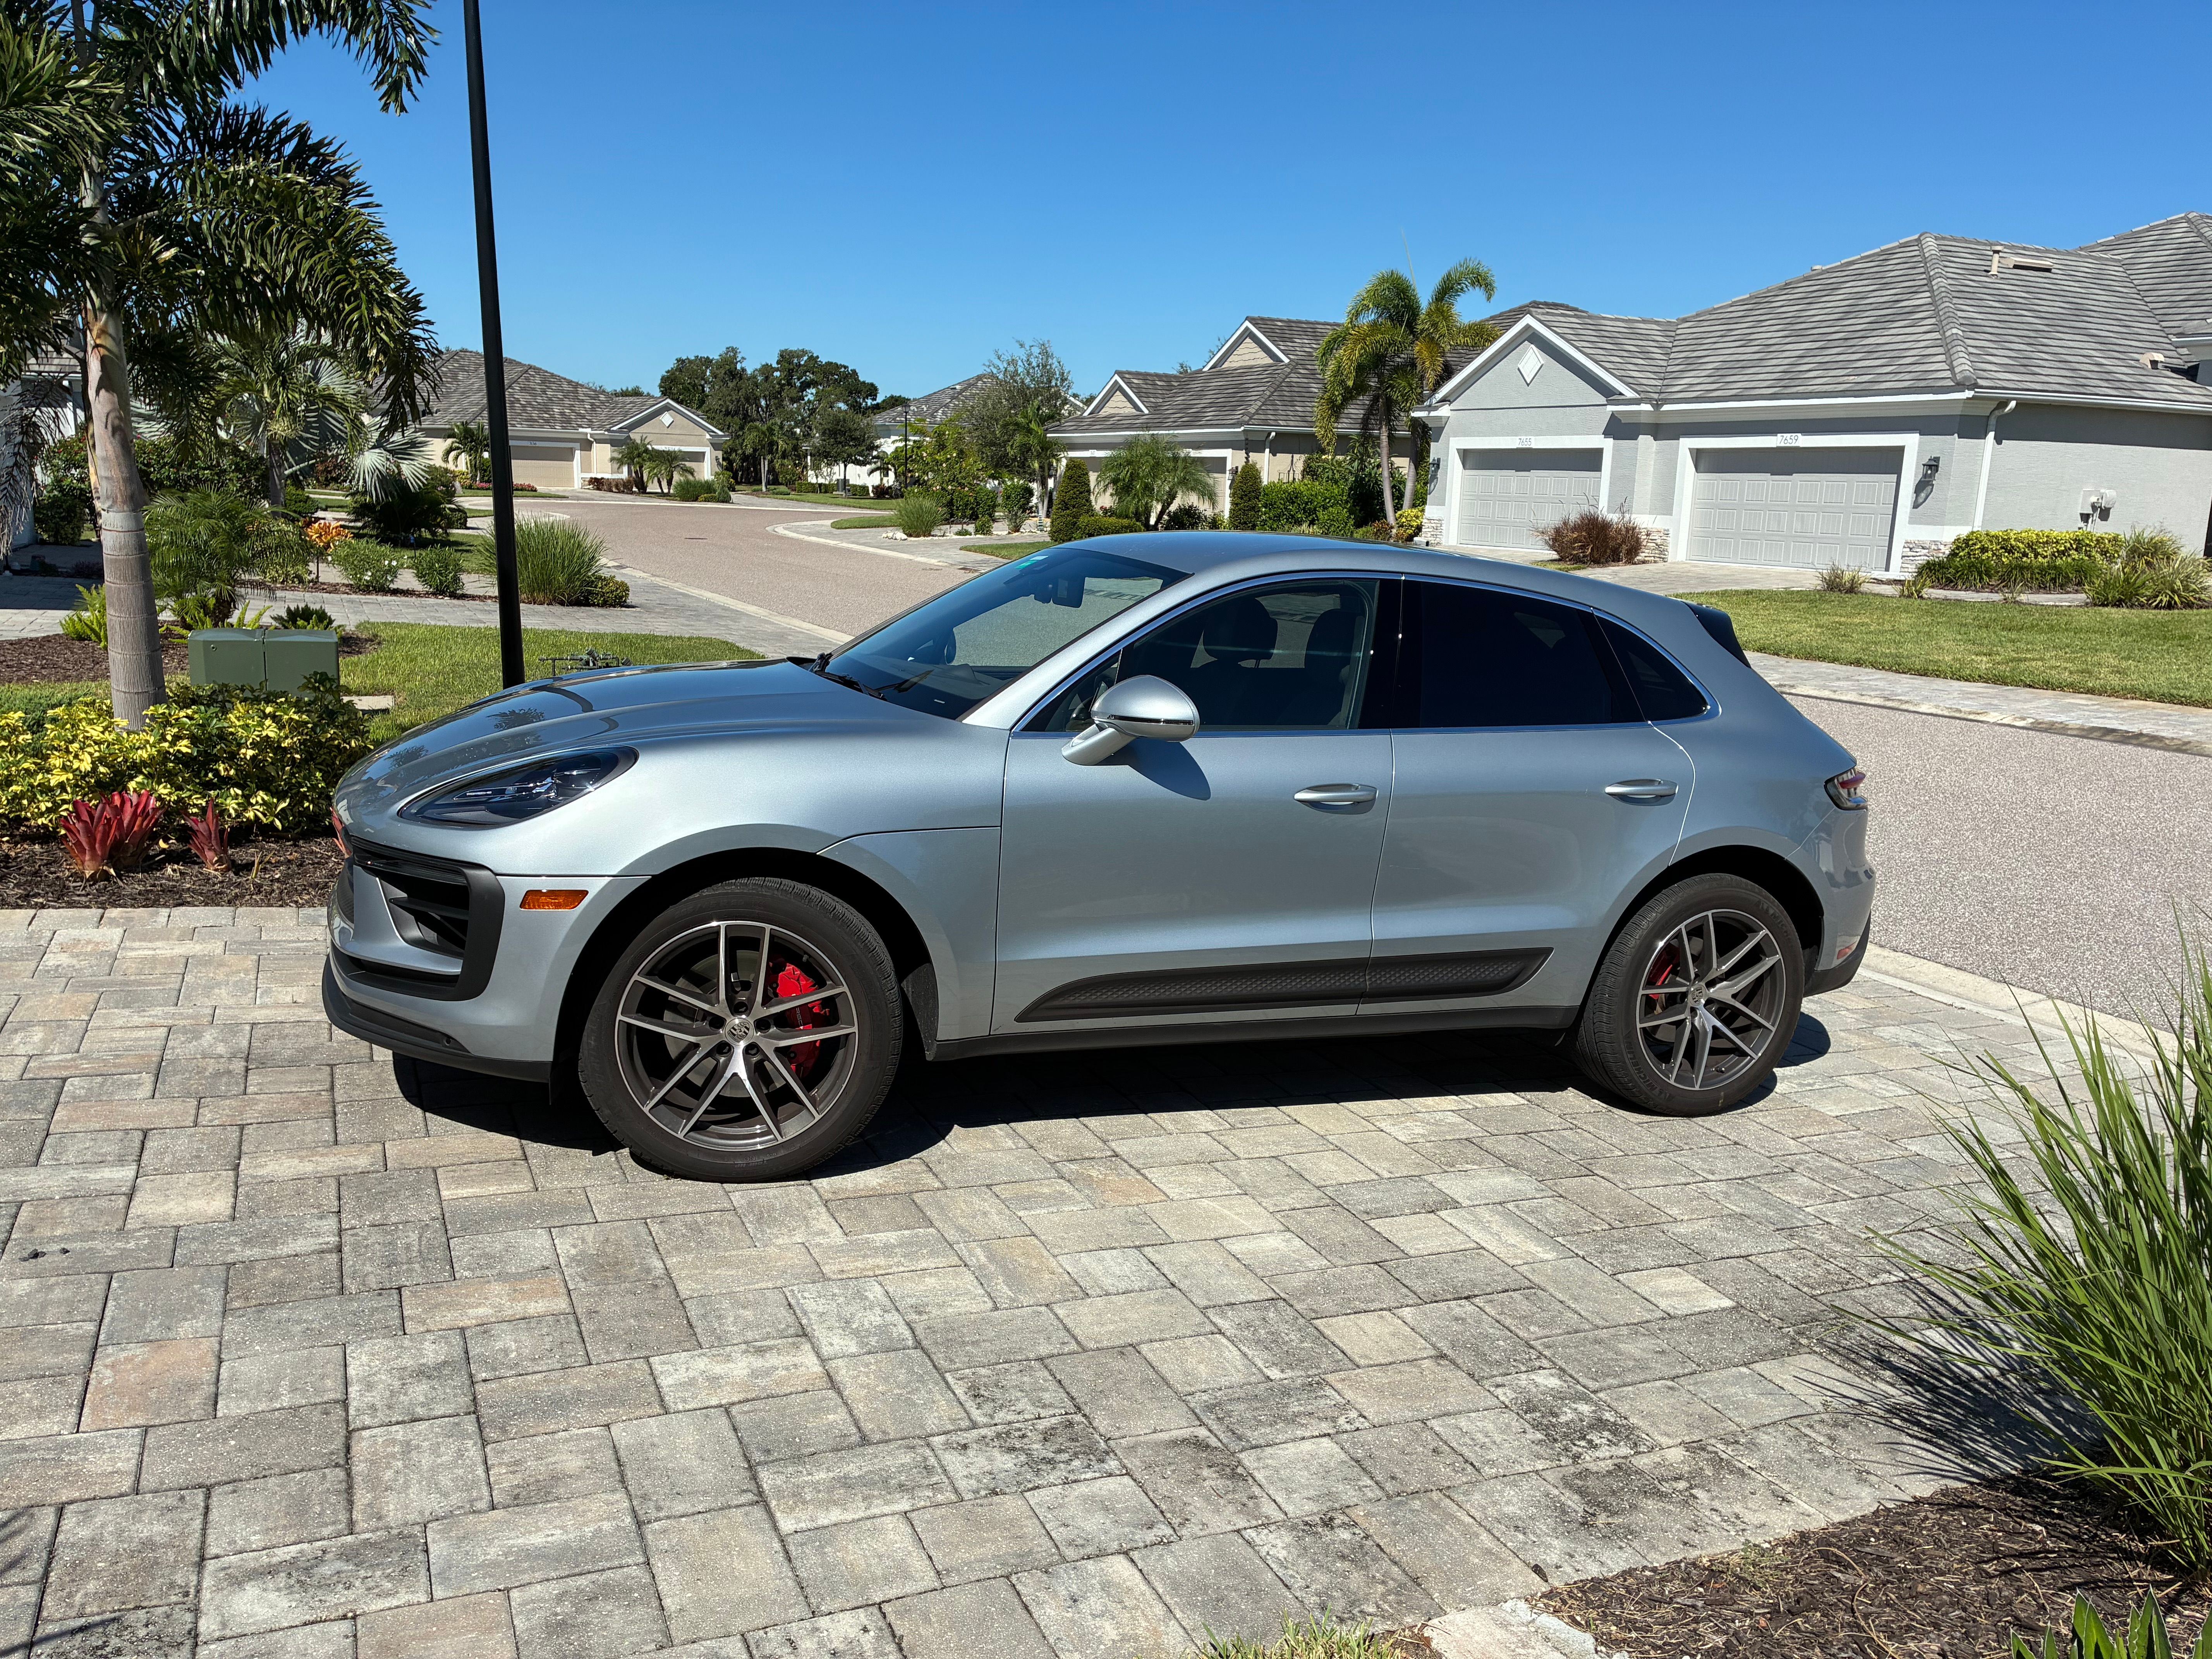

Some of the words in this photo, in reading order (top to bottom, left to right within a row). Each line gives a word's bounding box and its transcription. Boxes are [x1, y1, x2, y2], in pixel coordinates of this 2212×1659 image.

[1518, 438, 1532, 446] 7655
[1779, 435, 1798, 444] 7659
[1625, 1041, 1658, 1091] MICHELIN
